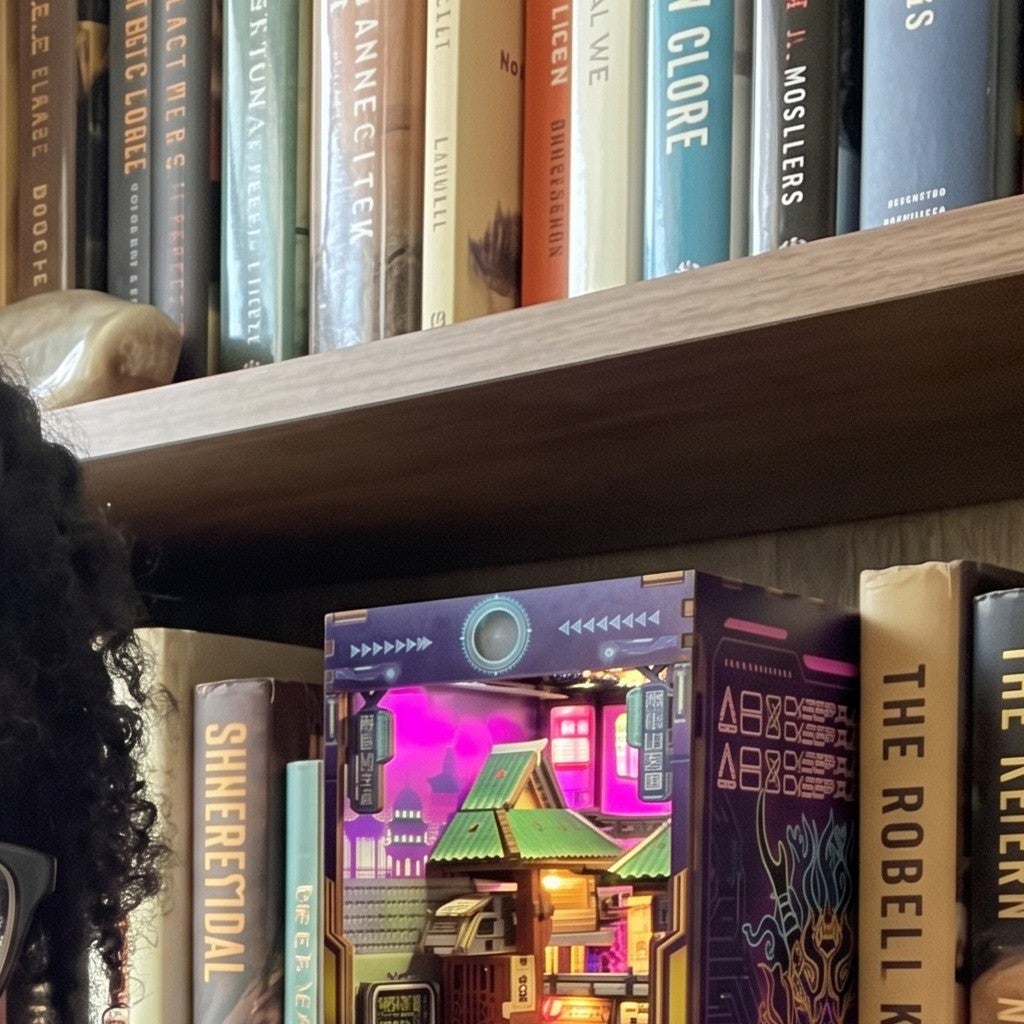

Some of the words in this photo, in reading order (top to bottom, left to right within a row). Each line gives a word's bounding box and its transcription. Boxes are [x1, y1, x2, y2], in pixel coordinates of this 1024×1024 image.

[550, 4, 570, 88] LICEN
[588, 33, 610, 87] WE
[666, 26, 711, 156] CLORE
[781, 65, 807, 206] MOSLLERS
[883, 663, 927, 761] THE
[880, 786, 925, 980] ROBELL
